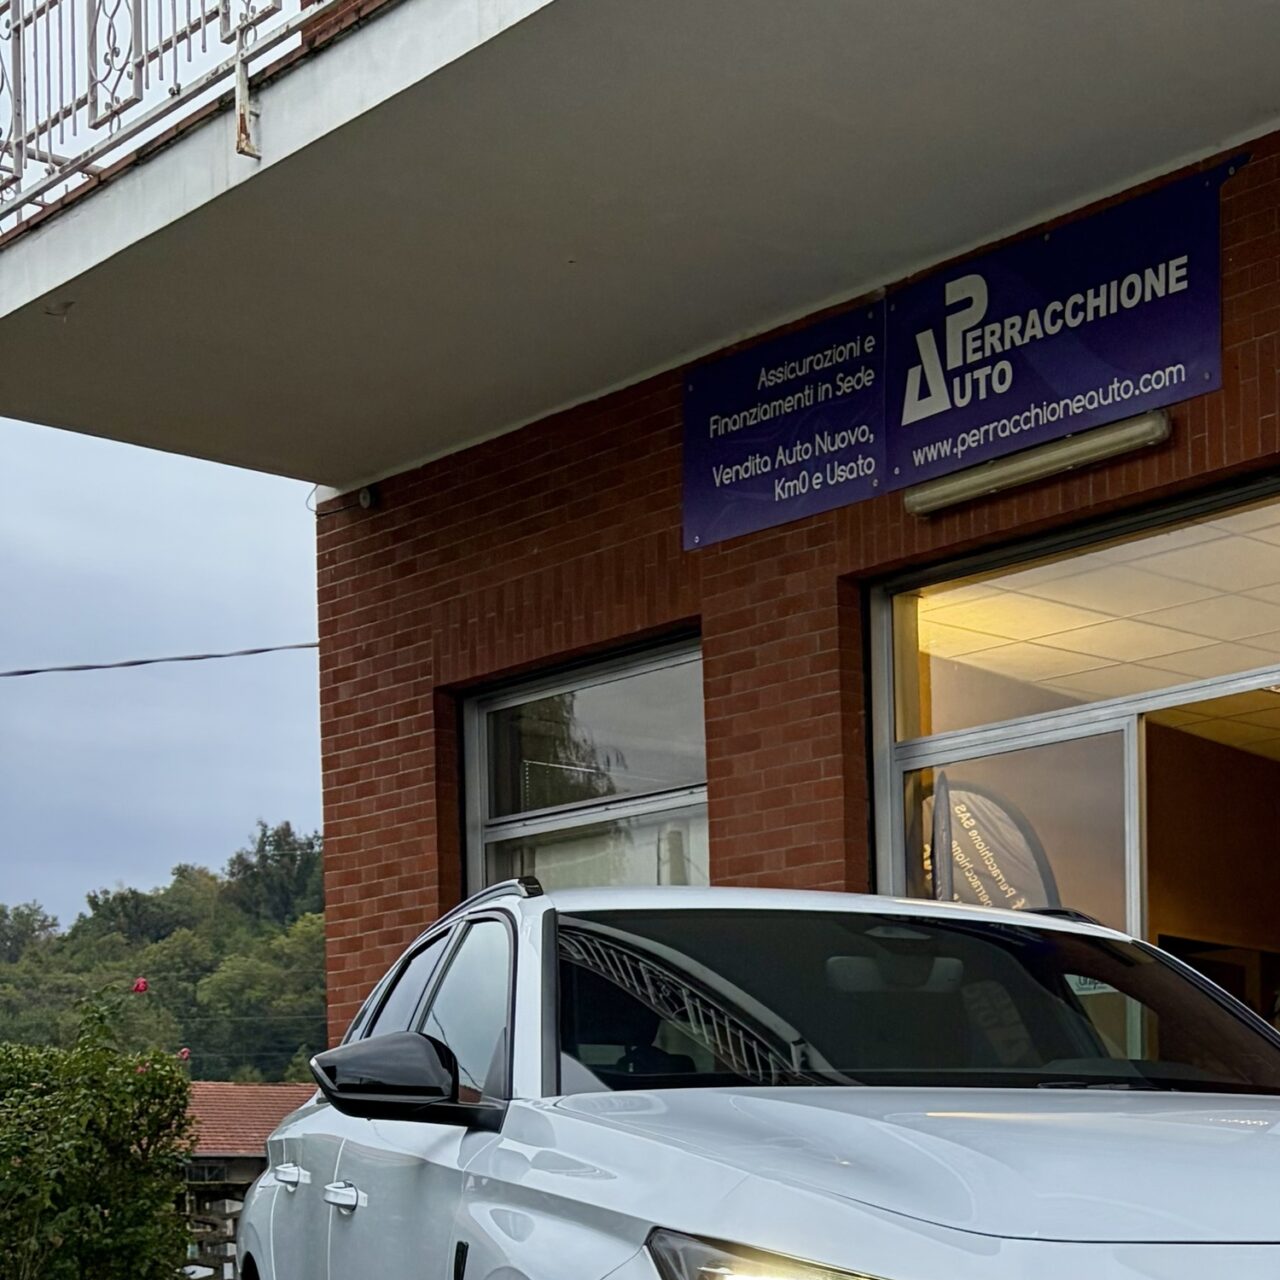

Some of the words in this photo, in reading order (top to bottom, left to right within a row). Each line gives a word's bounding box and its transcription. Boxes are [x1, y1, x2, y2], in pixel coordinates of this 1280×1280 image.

[945, 255, 1189, 368] PERRACCHIONE
[757, 338, 861, 390] Assicurazioni
[864, 335, 876, 353] e
[901, 328, 1013, 426] AUTO
[709, 384, 815, 438] Finanziamenti
[818, 383, 833, 403] in
[836, 367, 875, 397] Sede
[912, 362, 1186, 467] www.perracchioneauto.com
[713, 454, 772, 487] Vendita
[775, 441, 812, 468] Auto
[815, 423, 875, 455] Nuovo,
[774, 474, 809, 501] Km0
[812, 474, 824, 491] e
[827, 455, 876, 487] Usato
